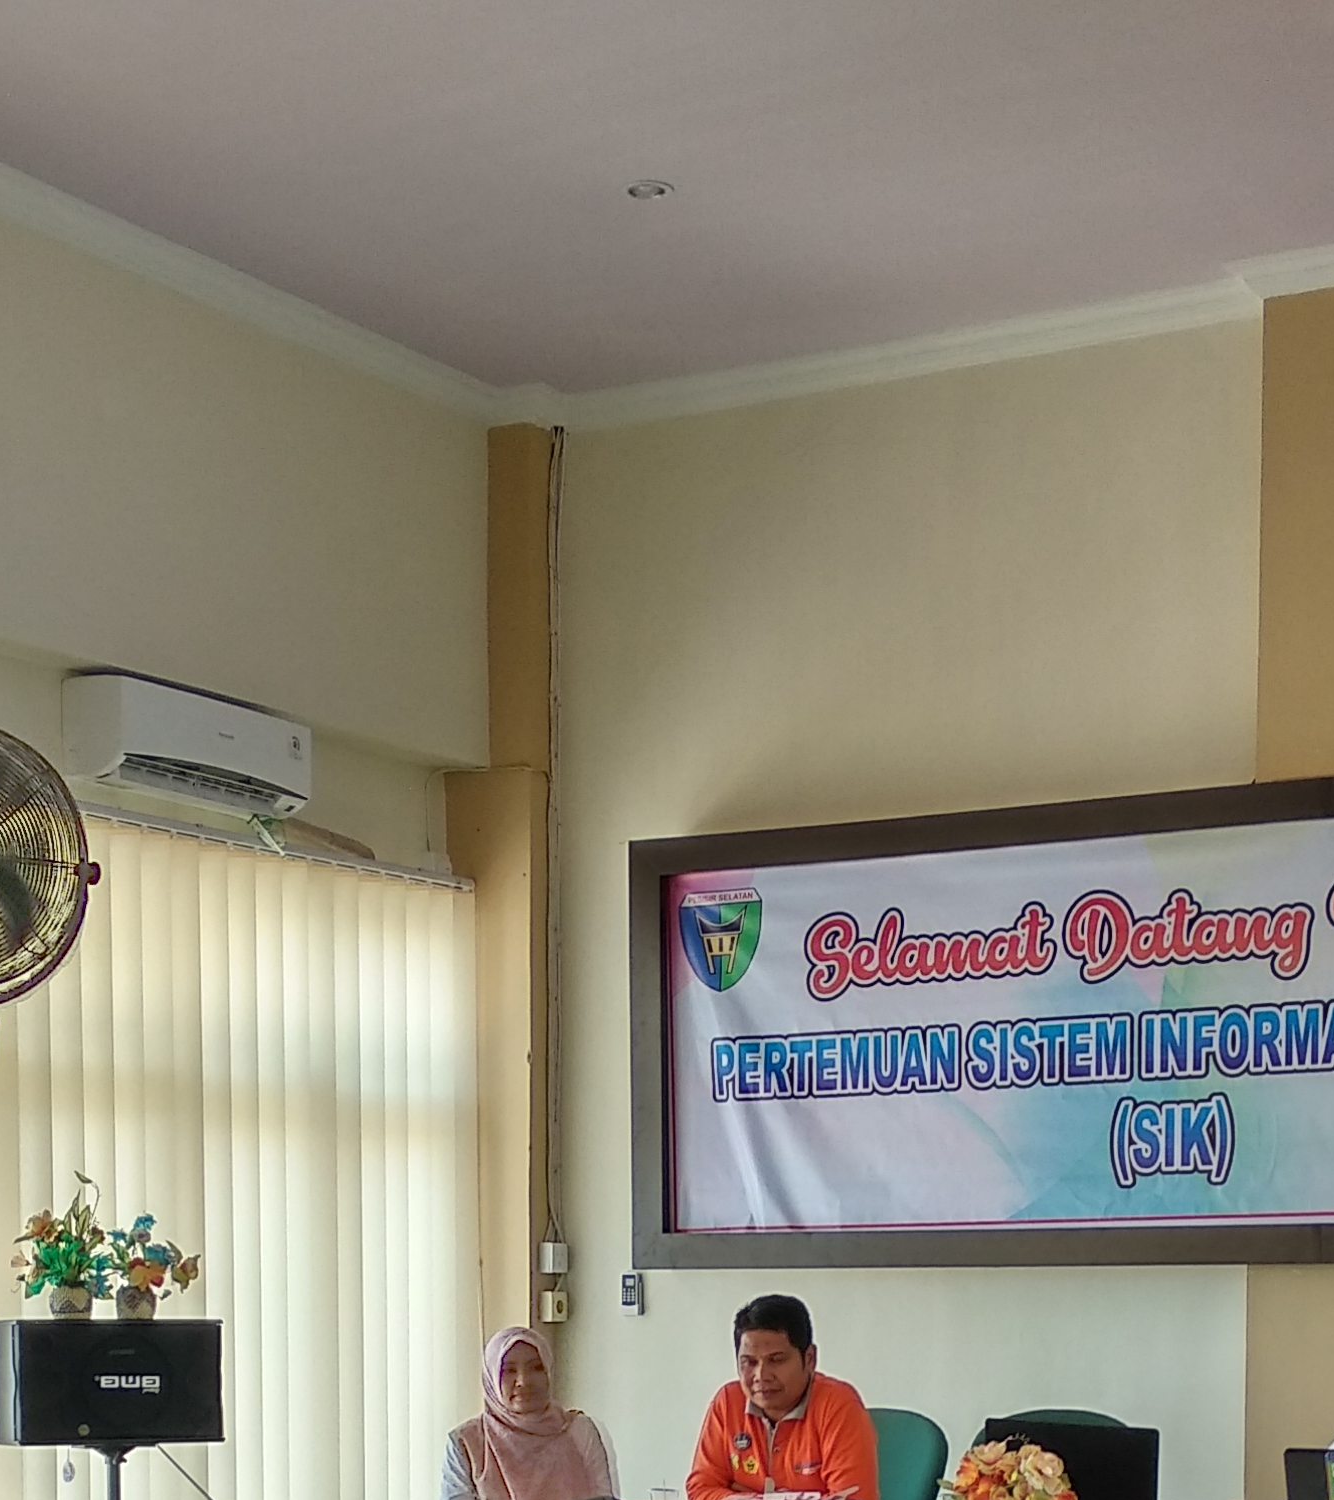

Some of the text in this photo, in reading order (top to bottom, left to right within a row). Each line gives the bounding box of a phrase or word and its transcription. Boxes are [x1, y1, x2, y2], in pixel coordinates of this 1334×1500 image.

[718, 892, 754, 902] SELATAN
[806, 907, 1054, 1000] Selamat
[1064, 890, 1312, 978] Datang
[713, 1026, 960, 1101] PERTEMUAN
[967, 1014, 1133, 1088] SISTEM
[1111, 1093, 1235, 1187] (SIK)
